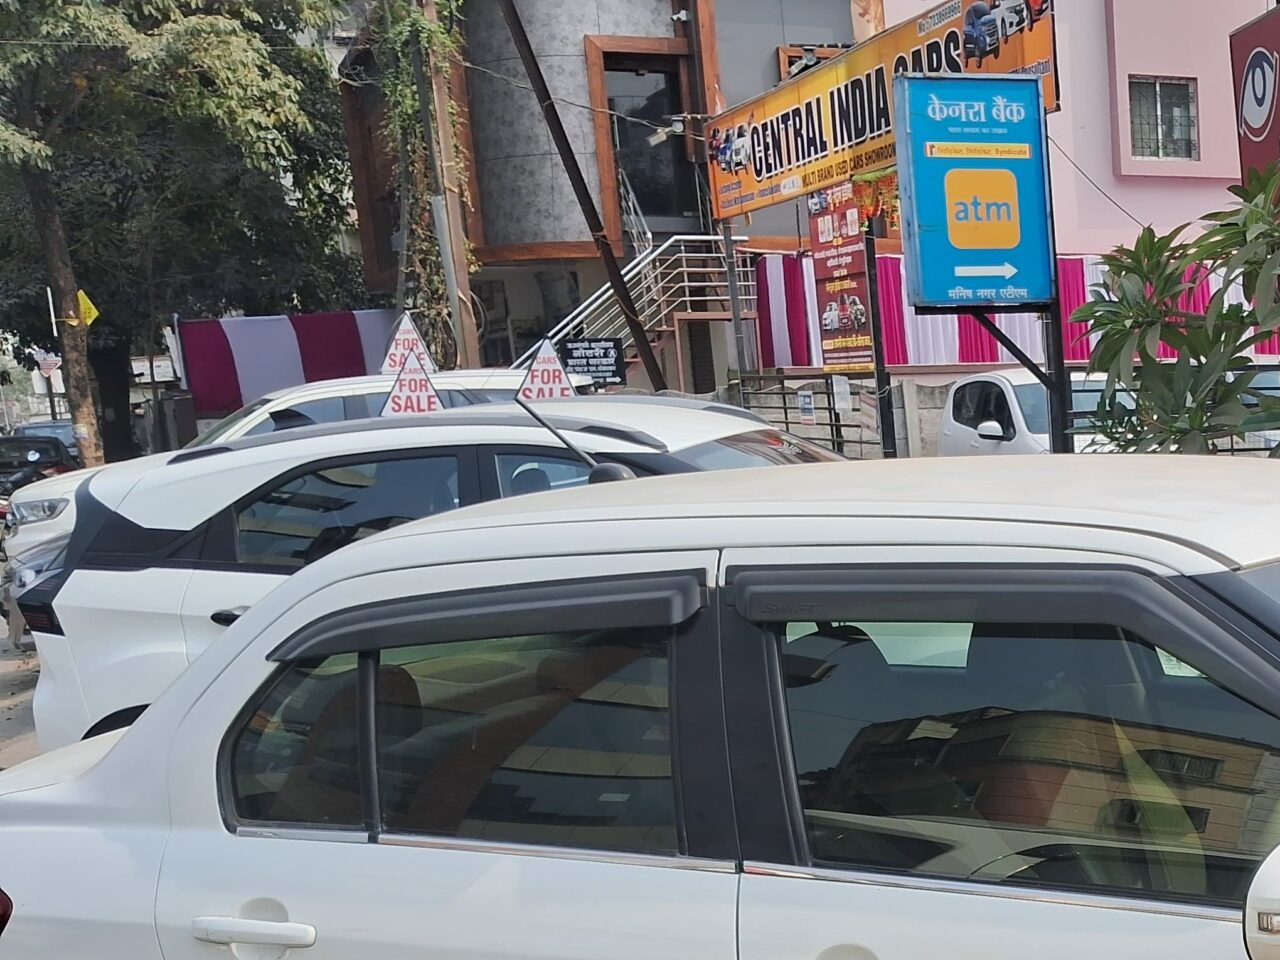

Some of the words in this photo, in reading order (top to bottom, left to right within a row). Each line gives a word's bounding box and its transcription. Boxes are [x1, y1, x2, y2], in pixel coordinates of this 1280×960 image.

[928, 94, 986, 122] केनरा
[992, 95, 1025, 122] बैंक
[751, 95, 827, 180] CENTRAL
[829, 66, 892, 147] INDIA
[802, 172, 818, 188] MULTI
[818, 165, 835, 183] BRAND
[835, 159, 849, 178] USED
[850, 153, 864, 174] CARS
[955, 195, 1012, 221] atm
[976, 288, 996, 299] नगर
[394, 338, 418, 351] FOR
[388, 352, 426, 368] SAE
[536, 356, 557, 365] CARS
[530, 369, 562, 385] FOR
[399, 379, 428, 393] FOR
[522, 387, 570, 400] SALE
[391, 395, 438, 413] SALE
